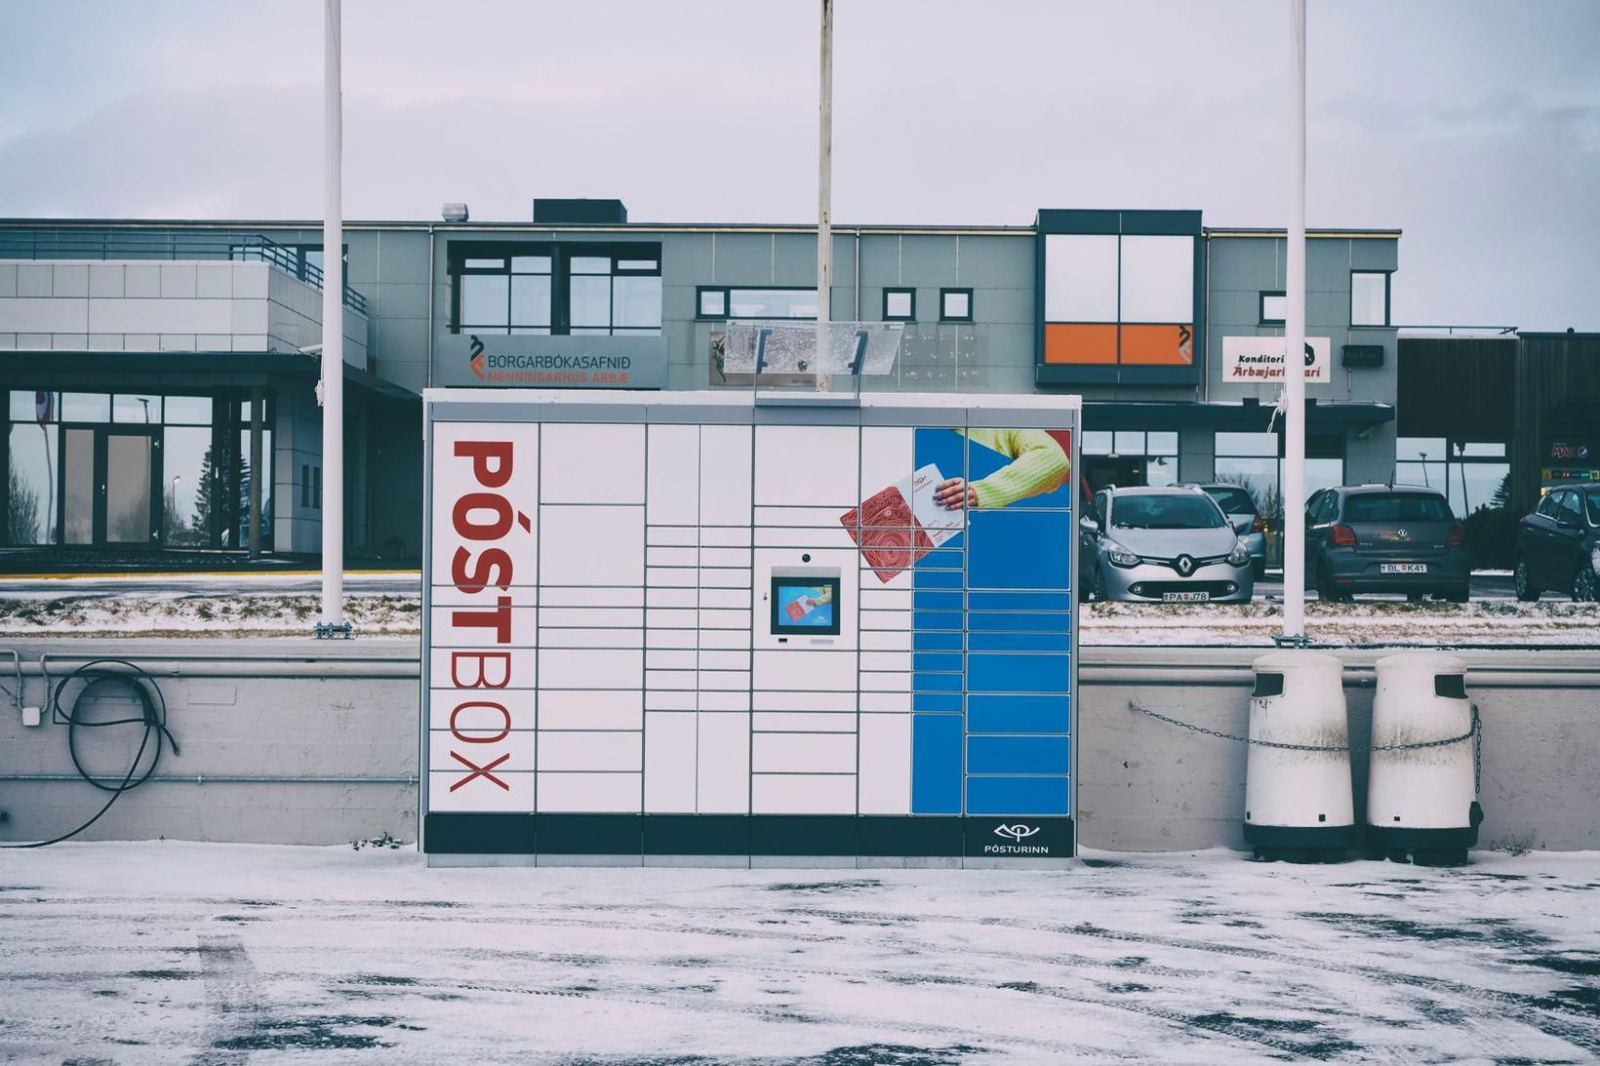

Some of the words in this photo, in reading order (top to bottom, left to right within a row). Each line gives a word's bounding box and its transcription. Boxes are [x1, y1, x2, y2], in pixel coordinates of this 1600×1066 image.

[488, 354, 631, 369] BORGARBÓKASAFNIÐ
[1238, 354, 1285, 364] Konditori
[1169, 593, 1183, 601] PA
[1190, 592, 1207, 601] J78
[450, 441, 531, 793] PÓSTBOX
[984, 844, 1049, 854] PÓSTURINN
